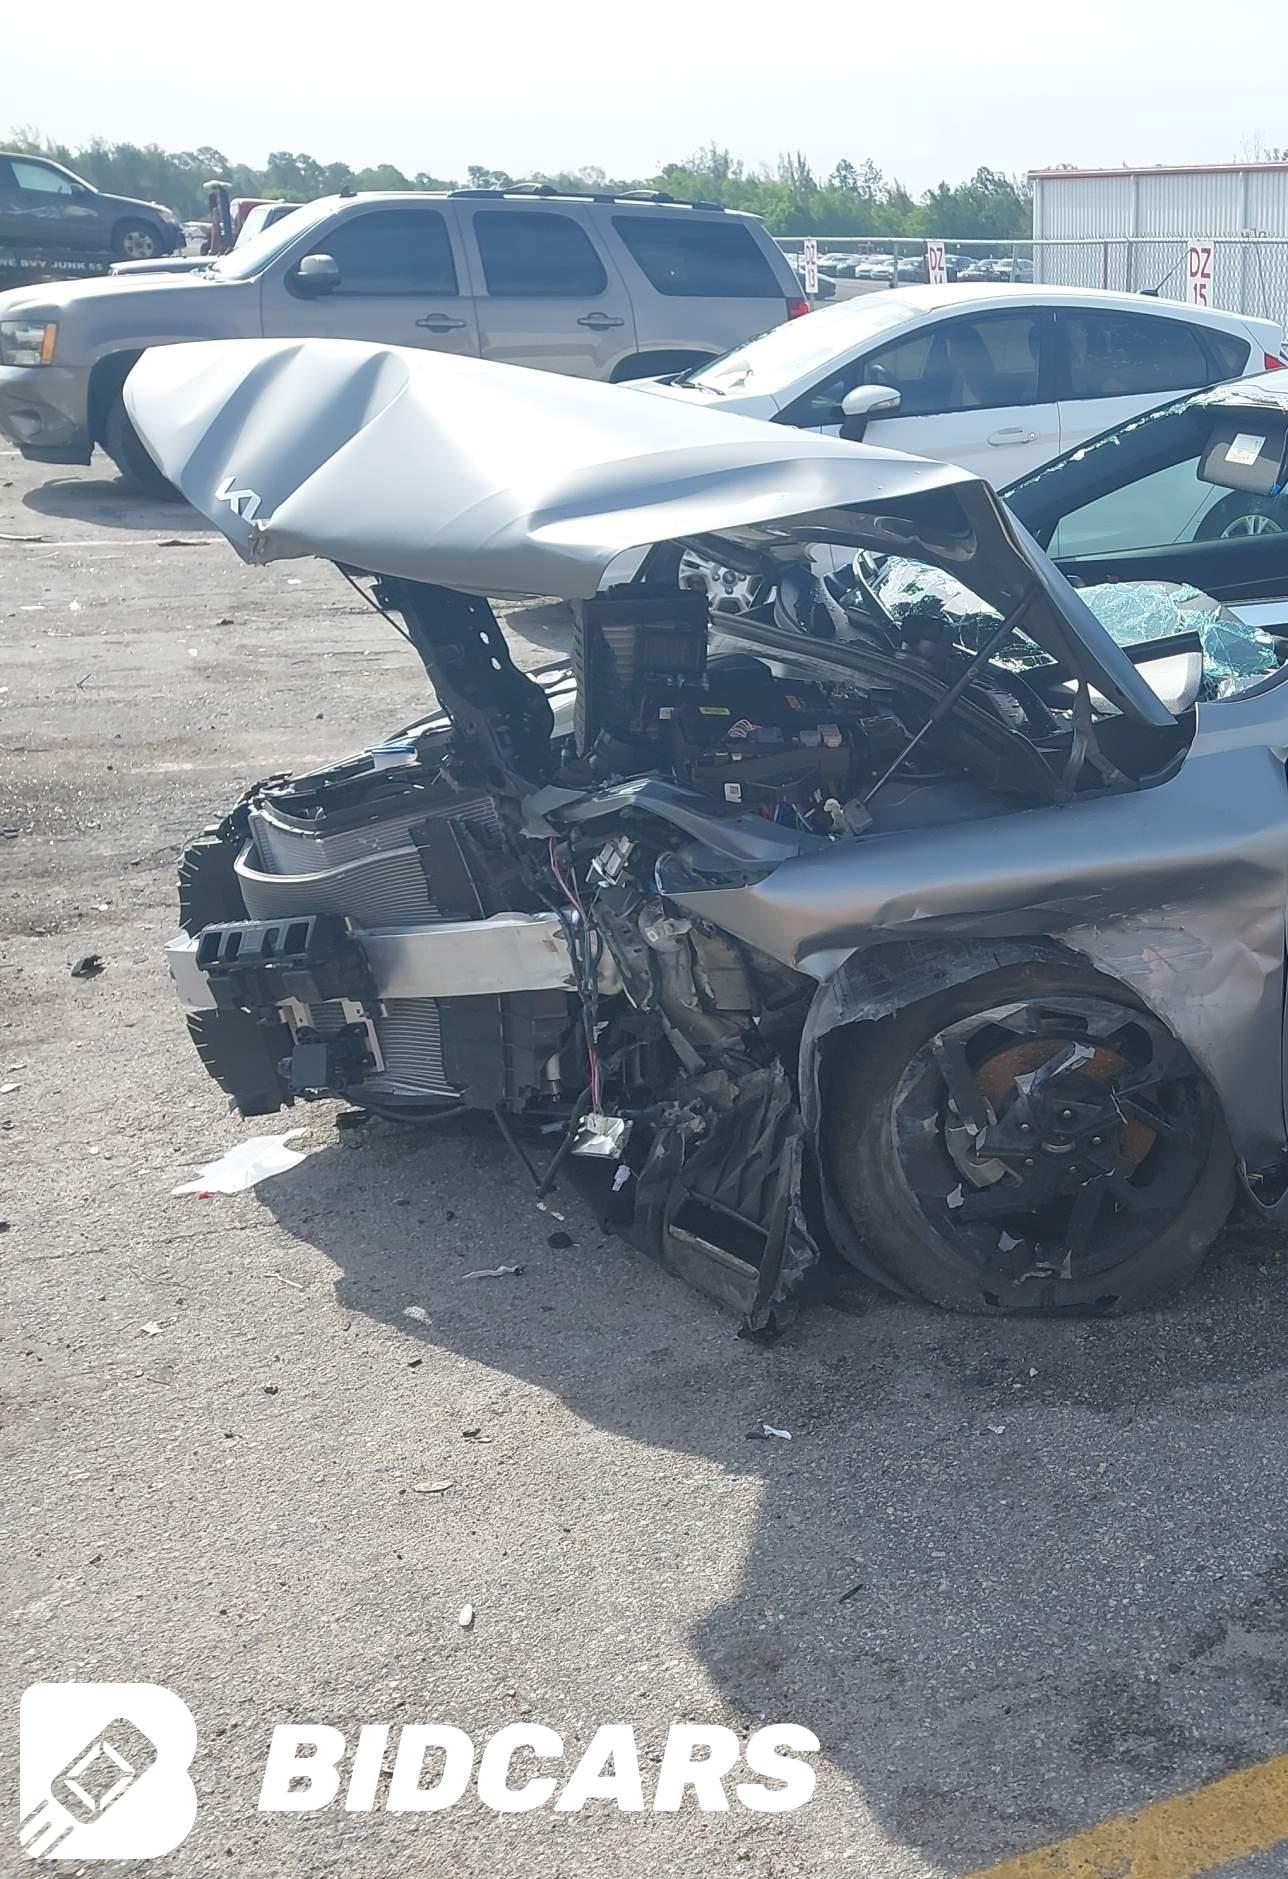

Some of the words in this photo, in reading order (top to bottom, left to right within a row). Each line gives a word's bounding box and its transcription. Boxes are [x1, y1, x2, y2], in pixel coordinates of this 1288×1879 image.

[50, 261, 86, 270] JUNK
[930, 247, 945, 271] DZ
[1189, 247, 1212, 279] DZ
[1193, 283, 1208, 306] 15
